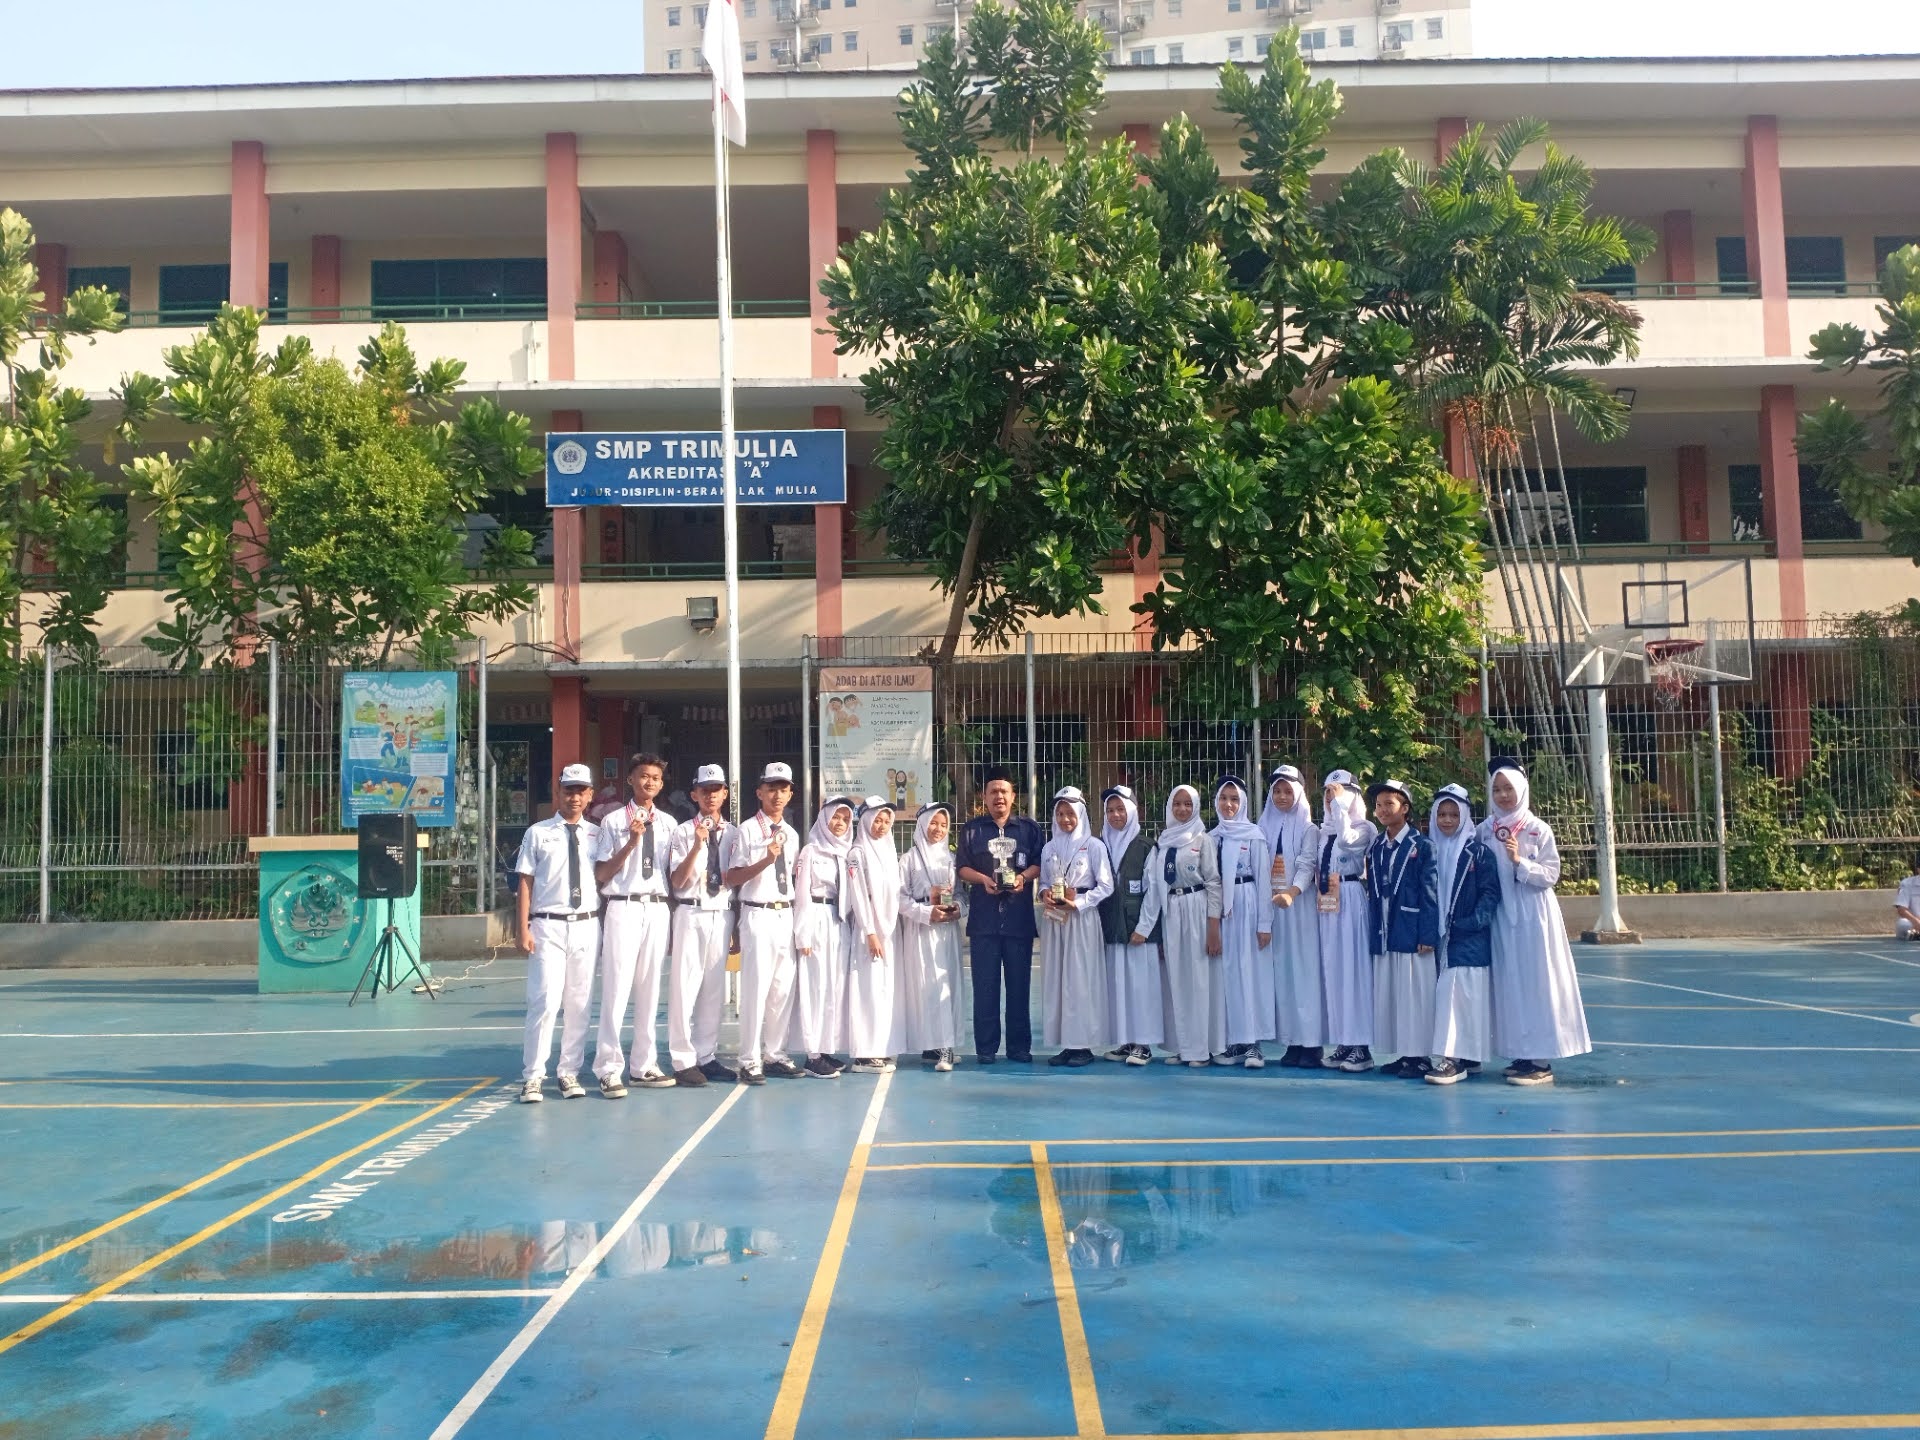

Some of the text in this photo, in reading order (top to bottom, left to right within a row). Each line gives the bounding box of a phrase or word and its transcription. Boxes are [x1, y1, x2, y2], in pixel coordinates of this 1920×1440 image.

[595, 440, 652, 459] SMP
[628, 466, 725, 480] AKREDITA
[775, 485, 818, 496] MULIA
[835, 675, 857, 687] ADAB
[870, 675, 892, 686] ATAS
[894, 674, 915, 686] ILMU
[272, 1181, 381, 1223] SMK
[340, 1120, 480, 1179] TRIMULIA
